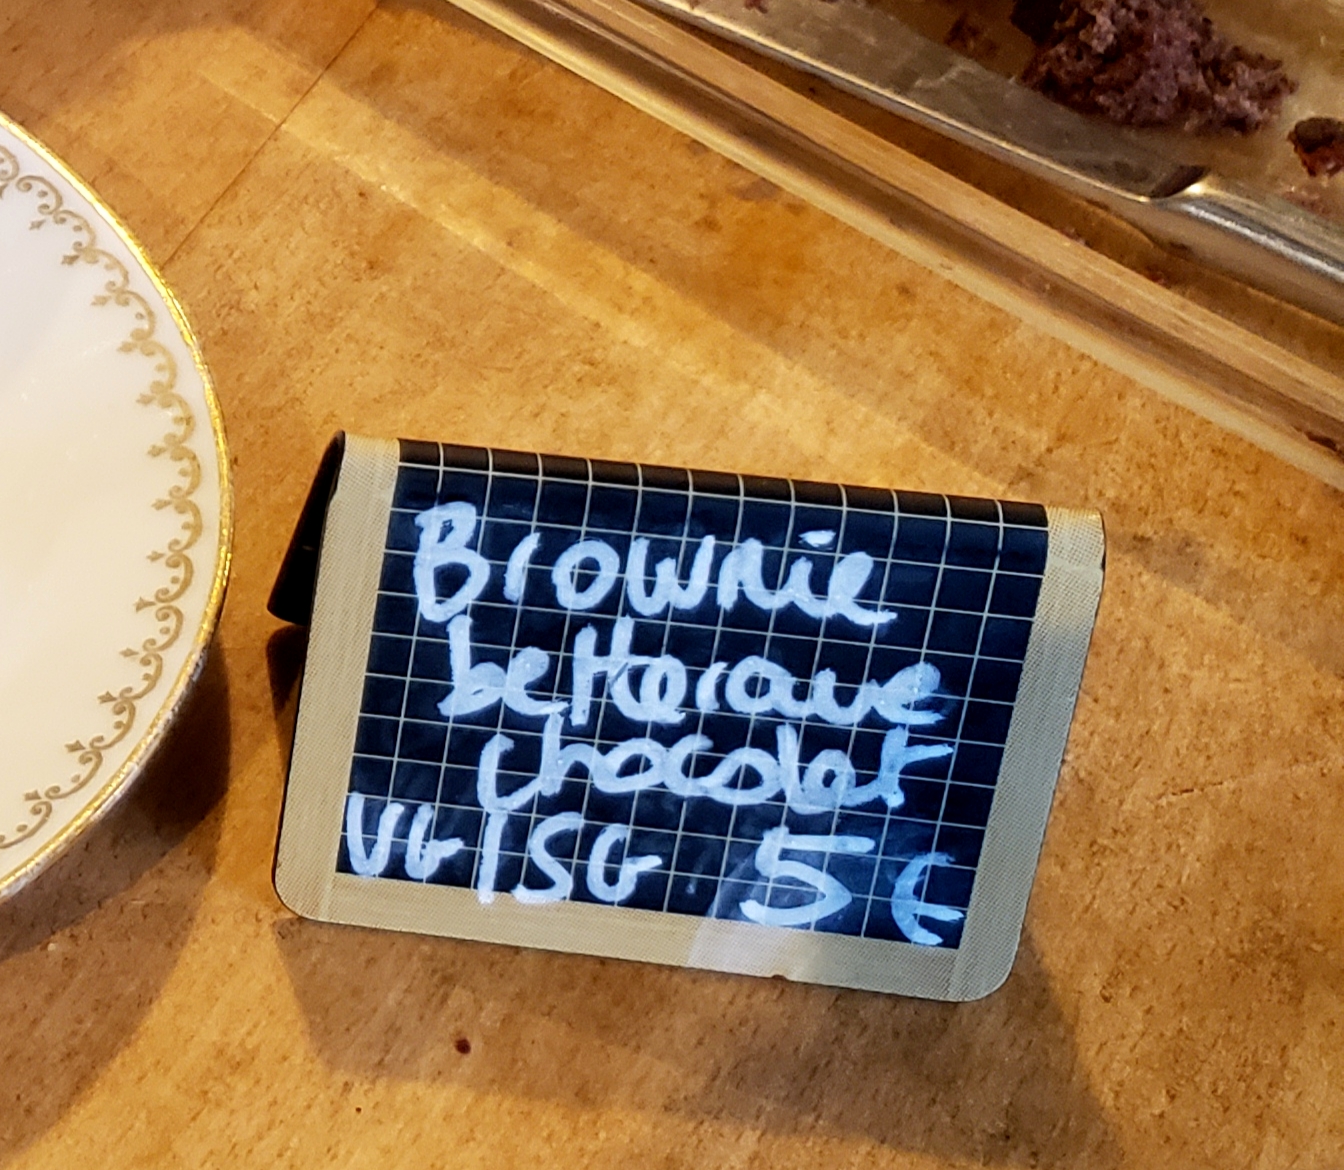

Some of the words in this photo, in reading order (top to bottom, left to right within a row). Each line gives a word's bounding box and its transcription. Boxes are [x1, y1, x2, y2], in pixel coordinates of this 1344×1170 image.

[413, 500, 899, 626] Brownie
[437, 616, 946, 727] betterave
[478, 712, 955, 814] chocolat
